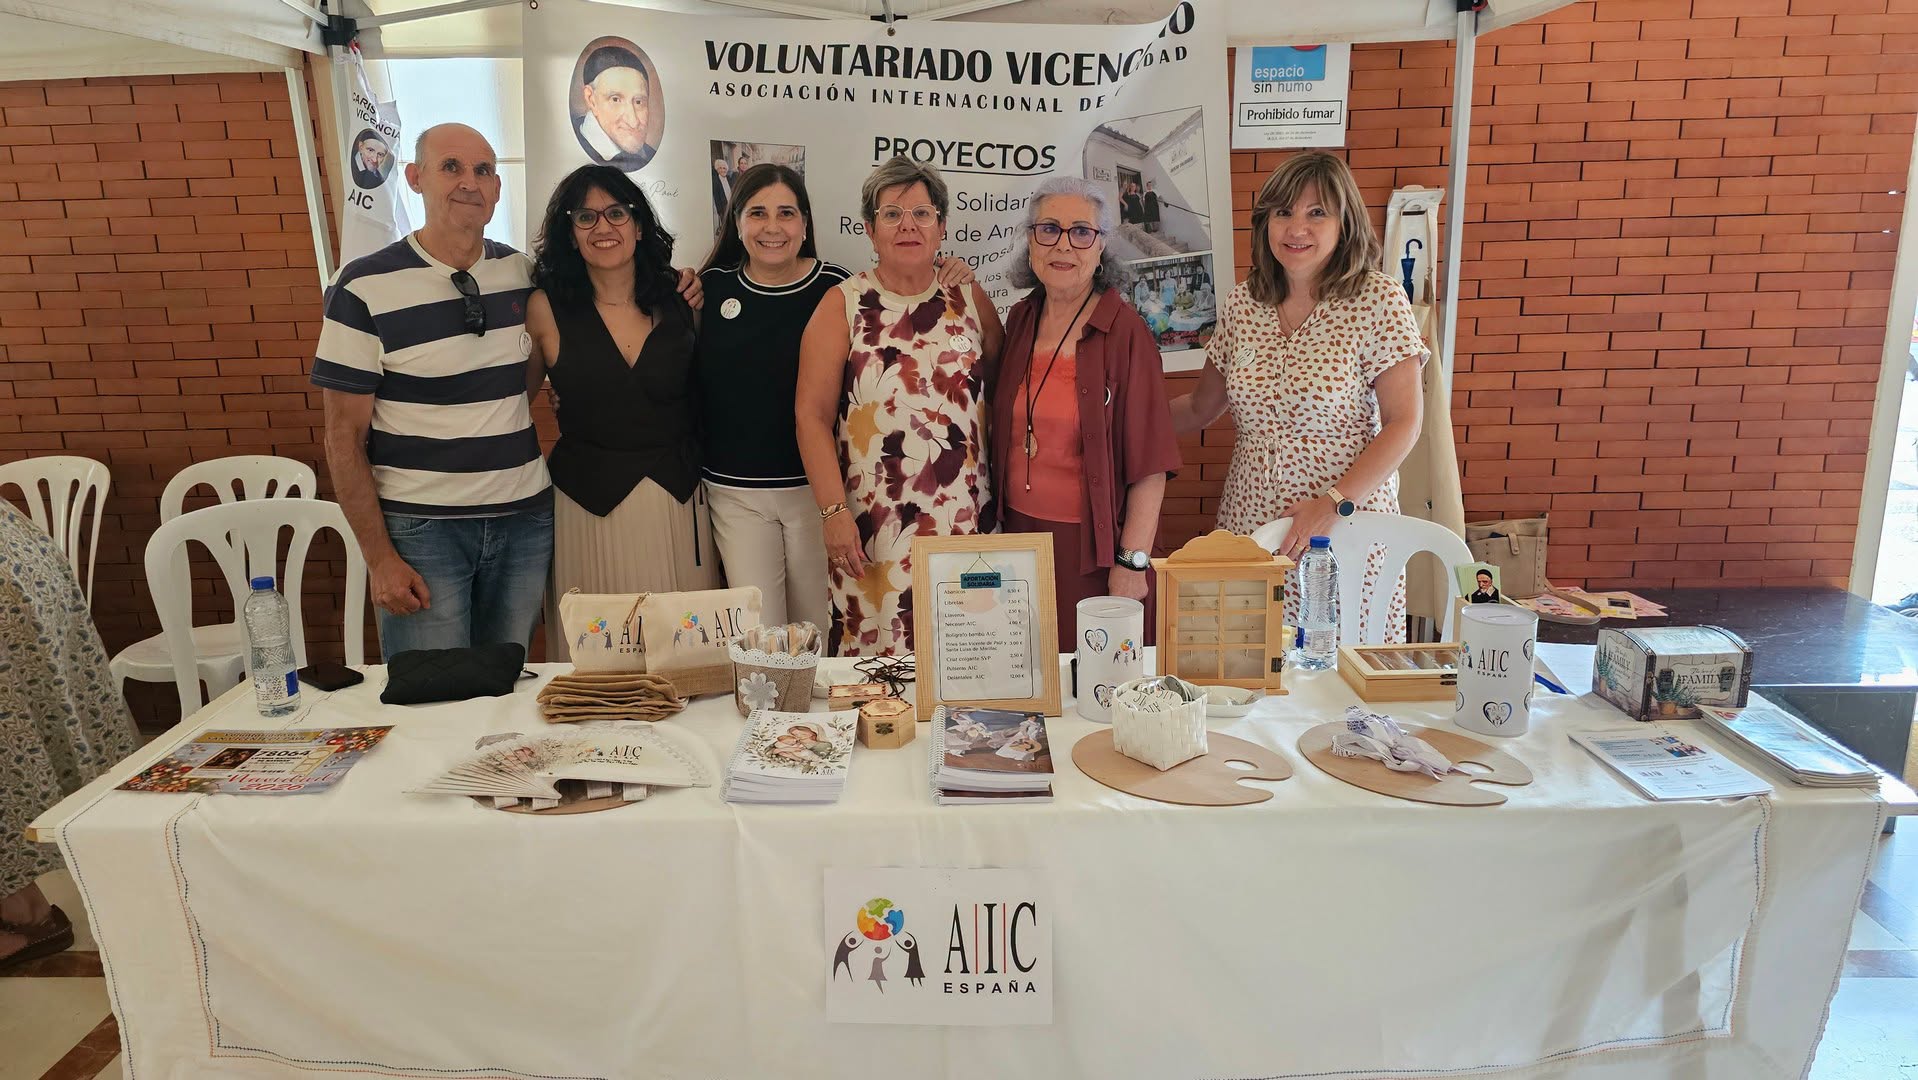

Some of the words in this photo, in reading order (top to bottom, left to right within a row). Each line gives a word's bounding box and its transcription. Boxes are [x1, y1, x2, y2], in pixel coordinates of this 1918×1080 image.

[704, 39, 993, 83] VOLUNTARIADO
[1254, 64, 1305, 81] espacio
[709, 81, 855, 102] ASOCIACIÓN
[872, 88, 1063, 113] INTERNACIONAL
[1079, 94, 1106, 112] DE
[1253, 81, 1272, 94] sin
[1277, 81, 1313, 93] humo
[1247, 108, 1300, 121] Prohibido
[1303, 107, 1335, 119] fumar
[873, 136, 1057, 171] PROYECTOS
[348, 189, 374, 210] AIC
[955, 223, 982, 242] de
[984, 272, 1002, 283] los
[620, 615, 643, 645] AI
[715, 607, 746, 639] AIC
[1478, 648, 1510, 672] AIC
[610, 745, 642, 758] AIC
[944, 901, 1037, 974] AIC
[944, 979, 1036, 994] ESPAÑA
